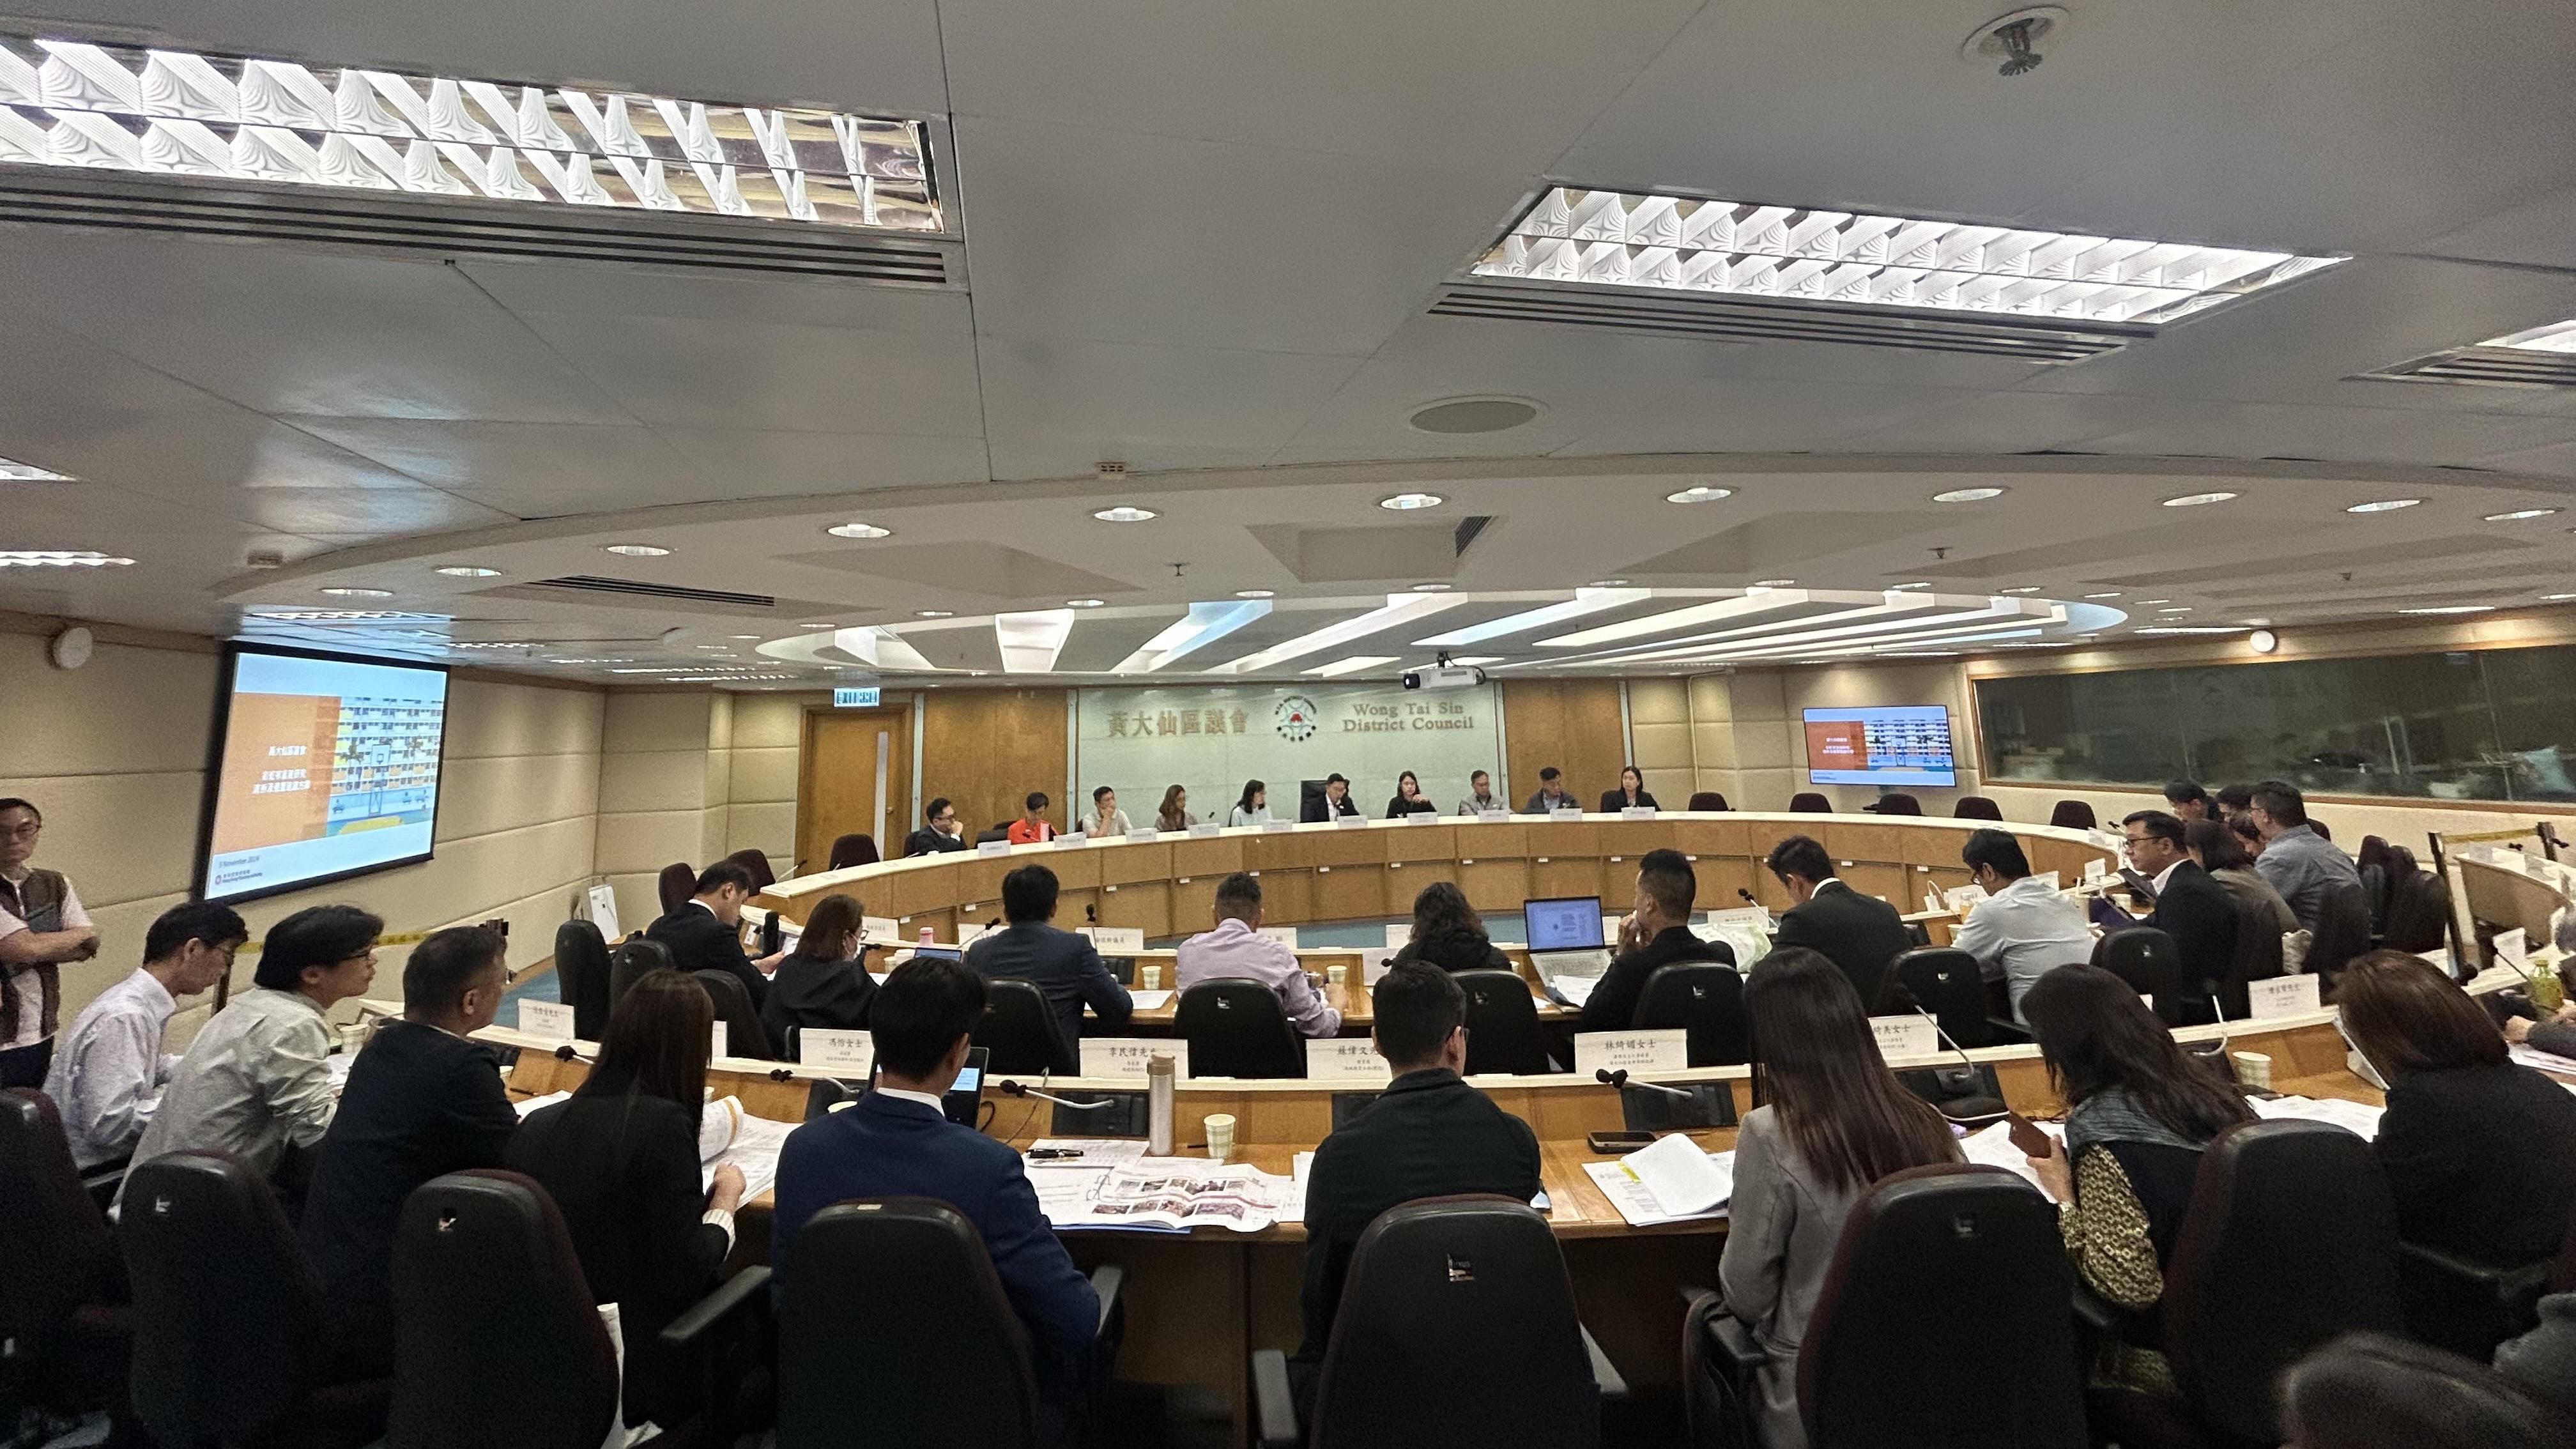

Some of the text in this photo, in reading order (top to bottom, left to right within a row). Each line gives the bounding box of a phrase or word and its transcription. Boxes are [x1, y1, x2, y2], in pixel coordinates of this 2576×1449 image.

[836, 691, 877, 704] EXIT 出口
[1353, 702, 1464, 718] Wong Tai Sin
[1107, 708, 1248, 737] 黃大仙區議會
[1342, 716, 1474, 732] District Council
